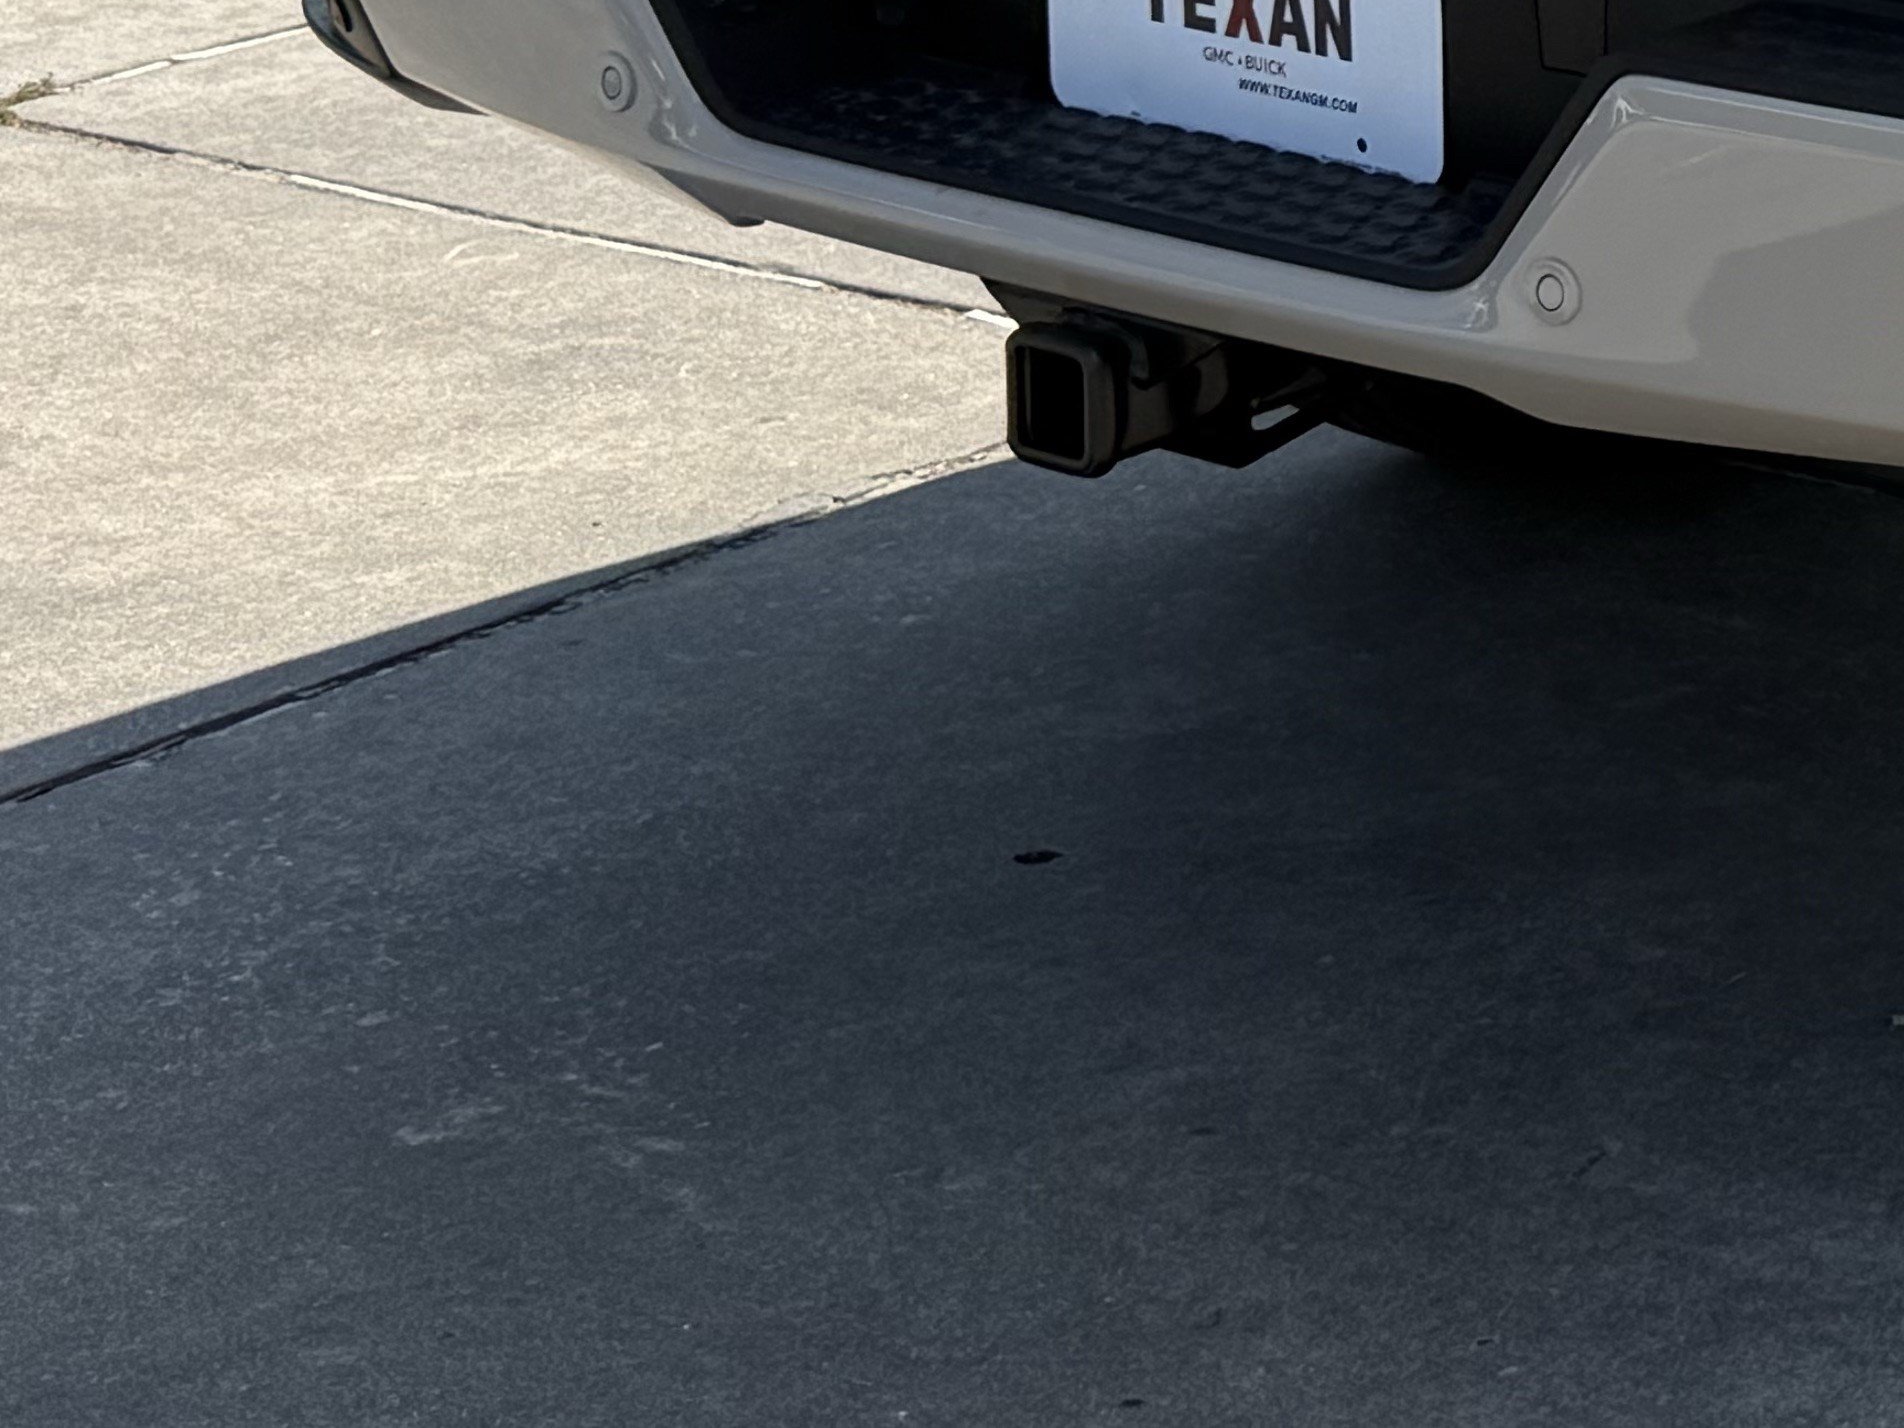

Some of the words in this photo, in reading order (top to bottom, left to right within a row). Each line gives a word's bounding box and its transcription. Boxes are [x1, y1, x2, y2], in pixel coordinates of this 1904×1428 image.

[1202, 45, 1235, 67] GMC
[1244, 54, 1288, 78] BUICK
[1238, 77, 1359, 114] WWW.TEXANGM.COM
